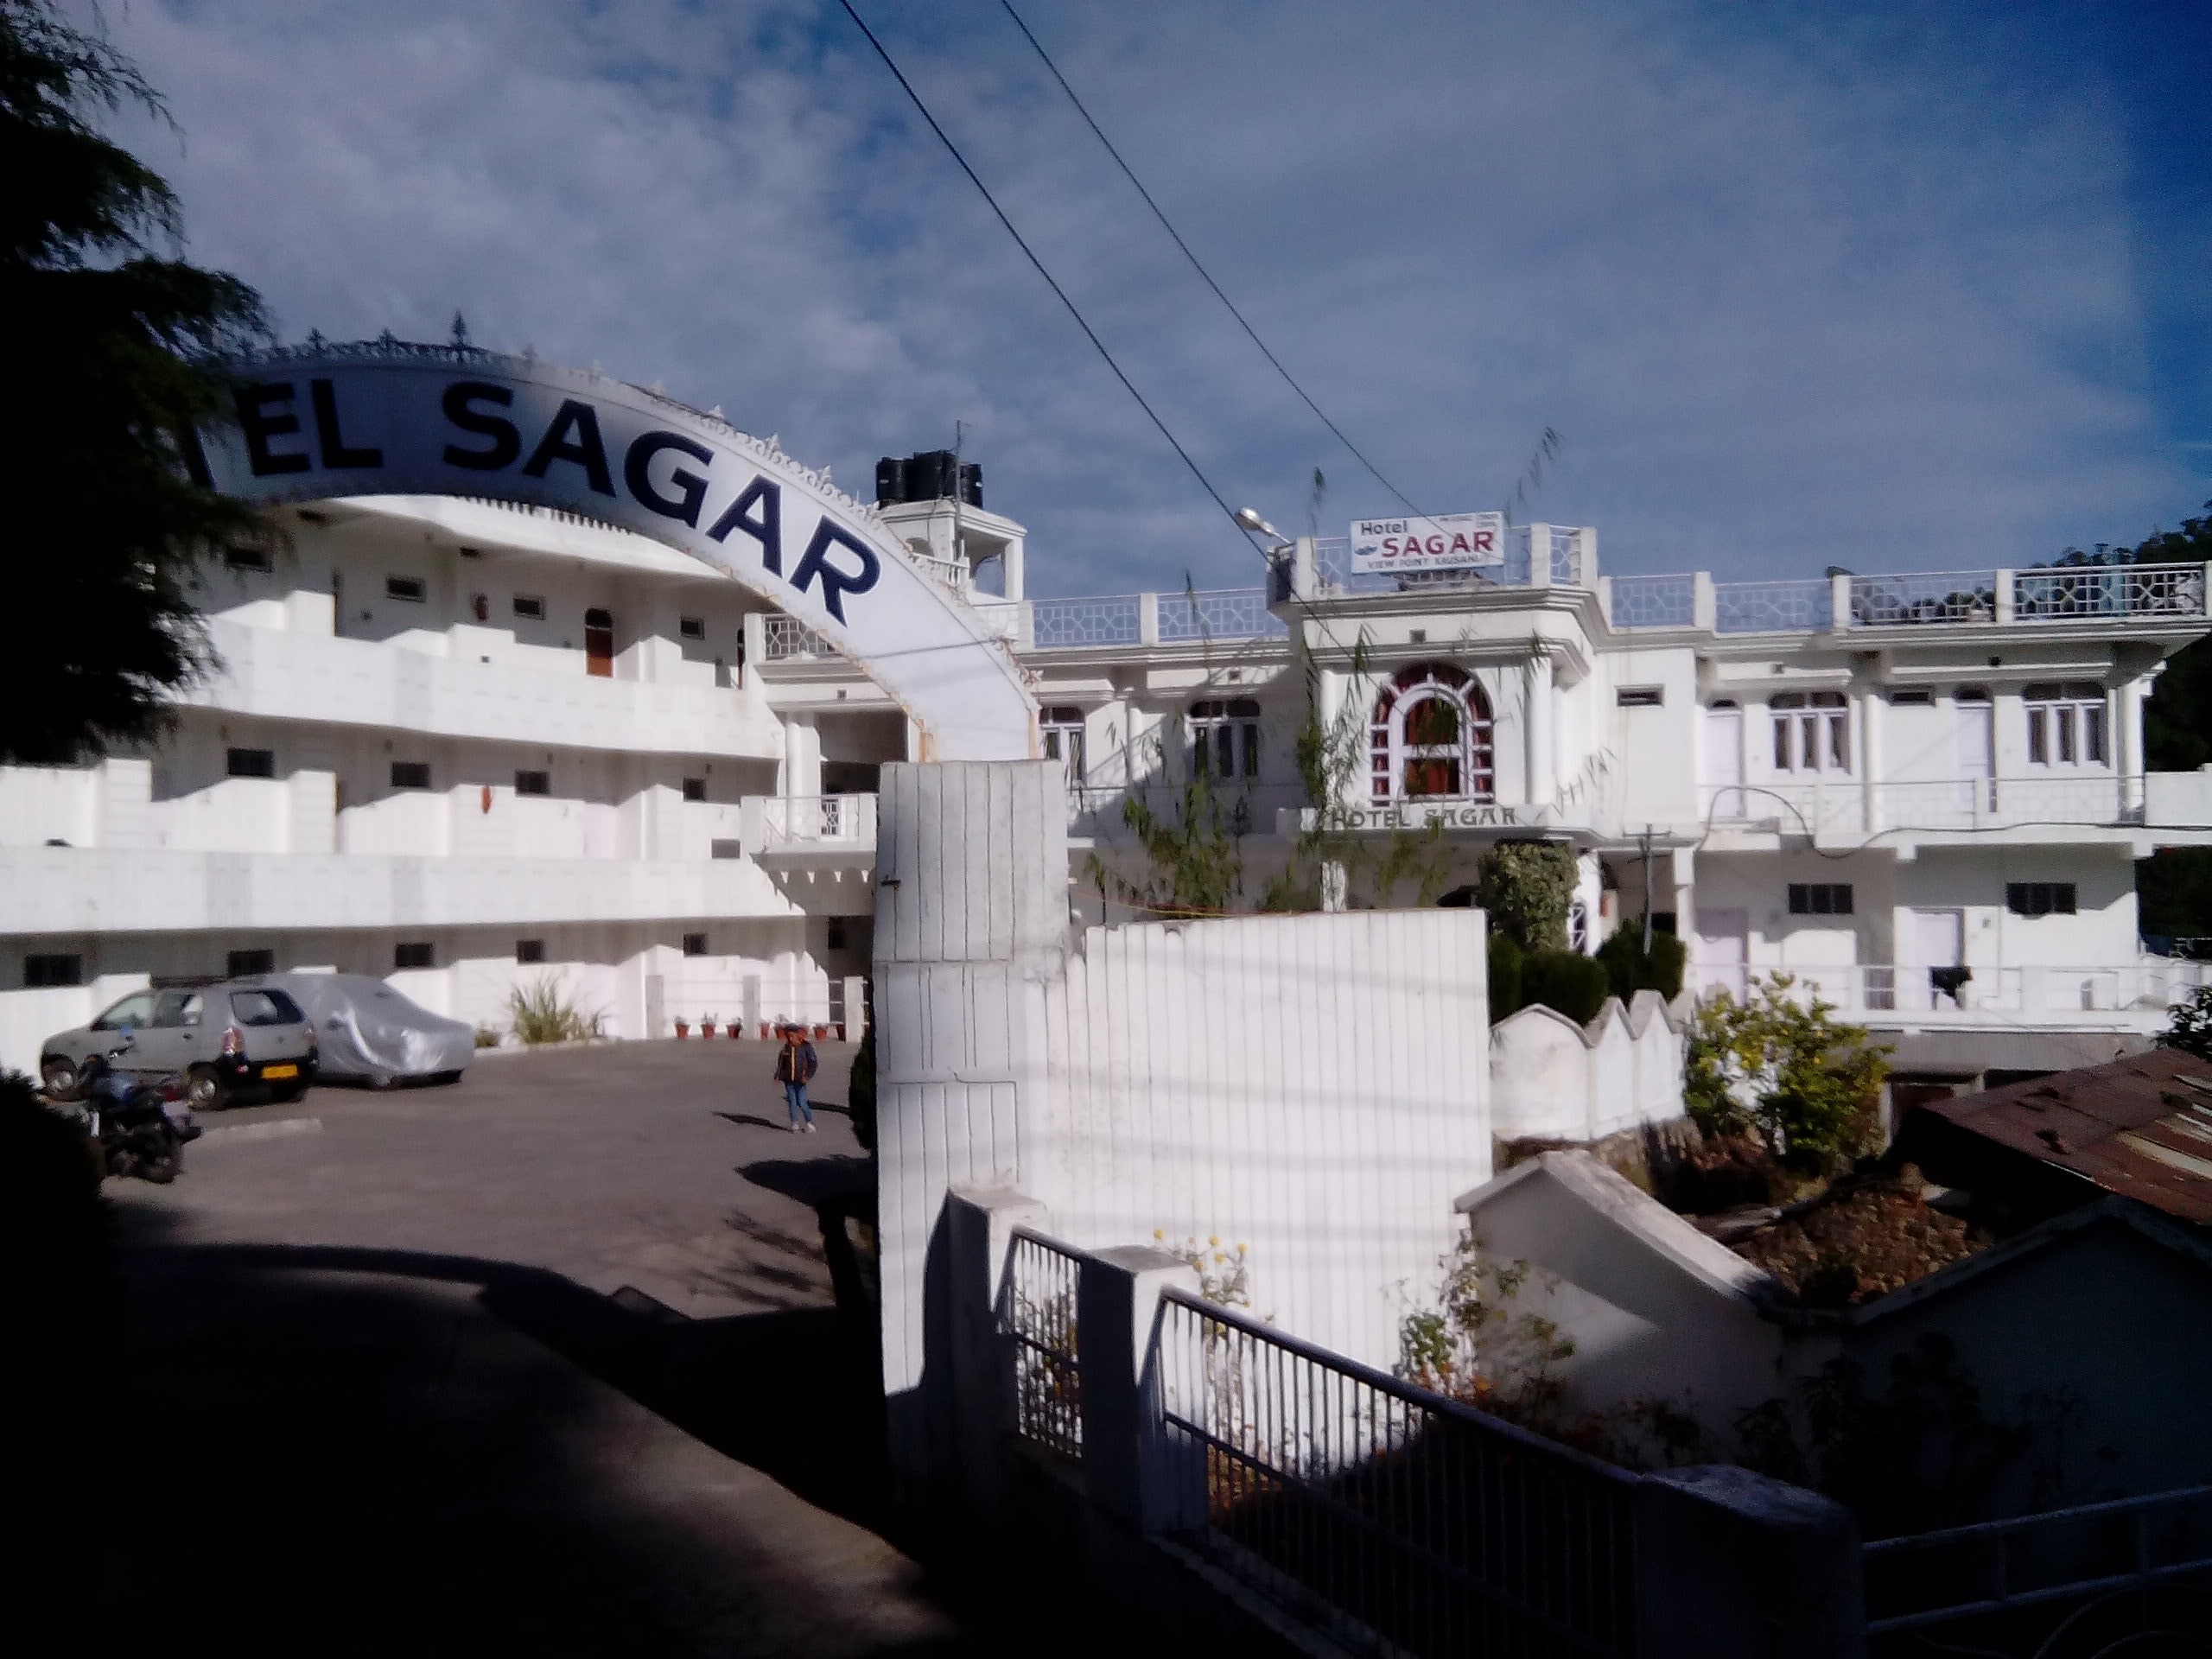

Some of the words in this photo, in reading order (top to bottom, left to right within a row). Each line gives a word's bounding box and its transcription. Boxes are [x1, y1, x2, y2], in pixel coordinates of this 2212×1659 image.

[441, 379, 881, 628] SAGAR
[1360, 519, 1408, 536] Hotel
[1382, 530, 1494, 558] SAGAR
[1332, 809, 1412, 828] HOTEL
[1424, 807, 1516, 828] SAGAR
